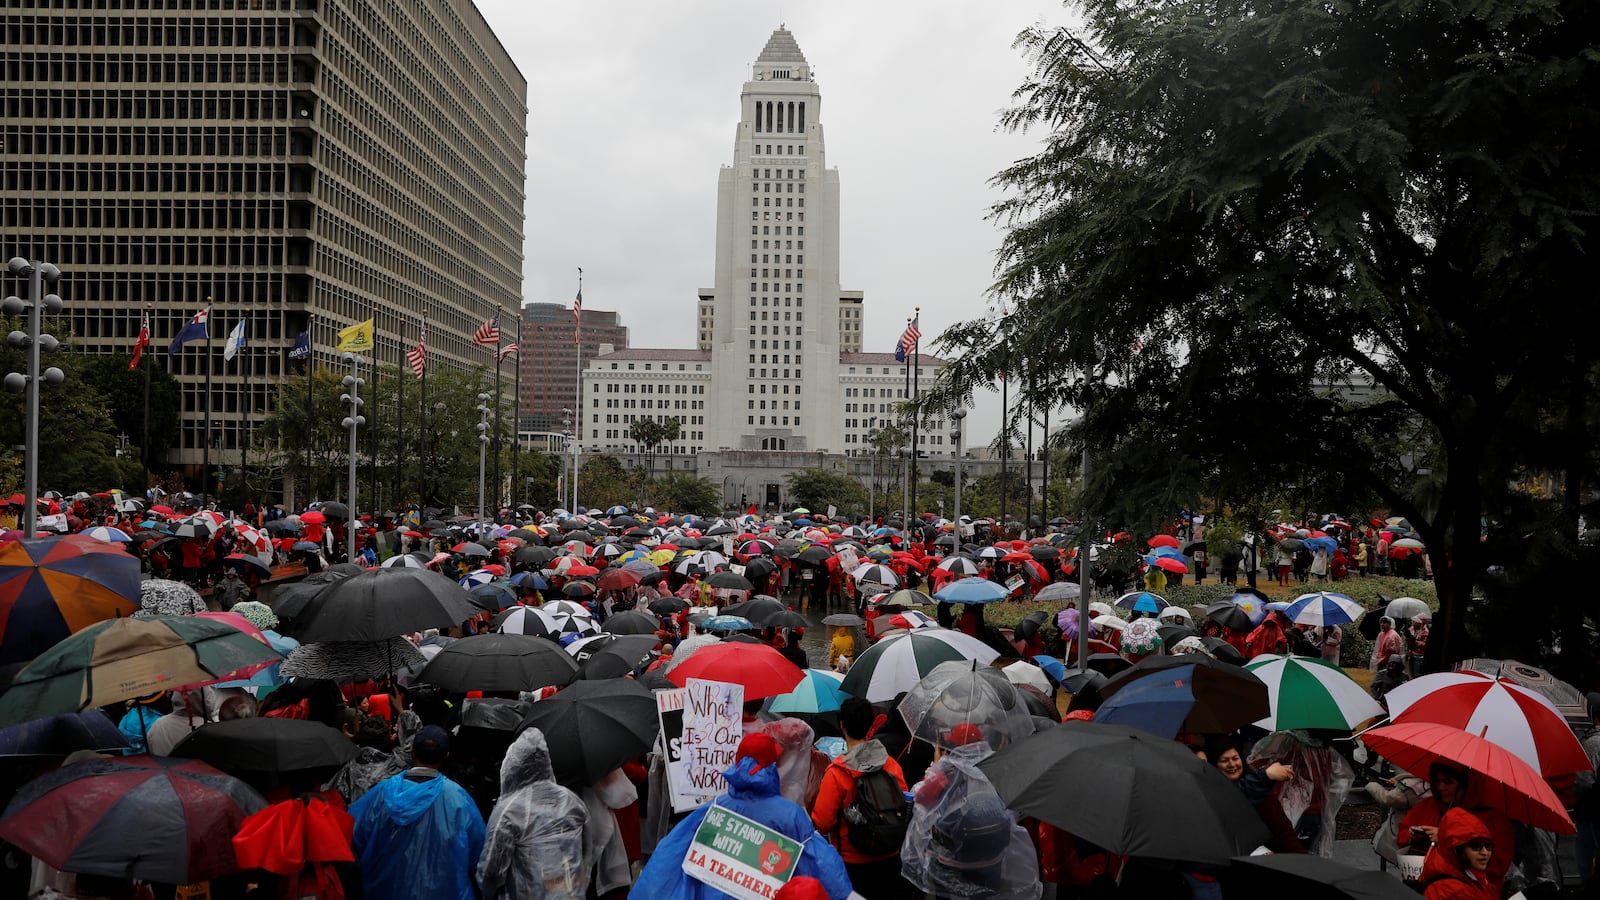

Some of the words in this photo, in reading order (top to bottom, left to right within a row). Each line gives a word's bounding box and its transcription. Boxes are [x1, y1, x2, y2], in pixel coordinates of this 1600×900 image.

[688, 685, 732, 724] What
[683, 727, 701, 745] Is
[715, 727, 741, 745] Our
[696, 747, 736, 766] FUTUR
[706, 810, 726, 827] WE
[725, 817, 766, 845] STAND
[712, 832, 744, 857] WITH
[688, 850, 706, 868] LA
[709, 859, 779, 900] TEACHERS
